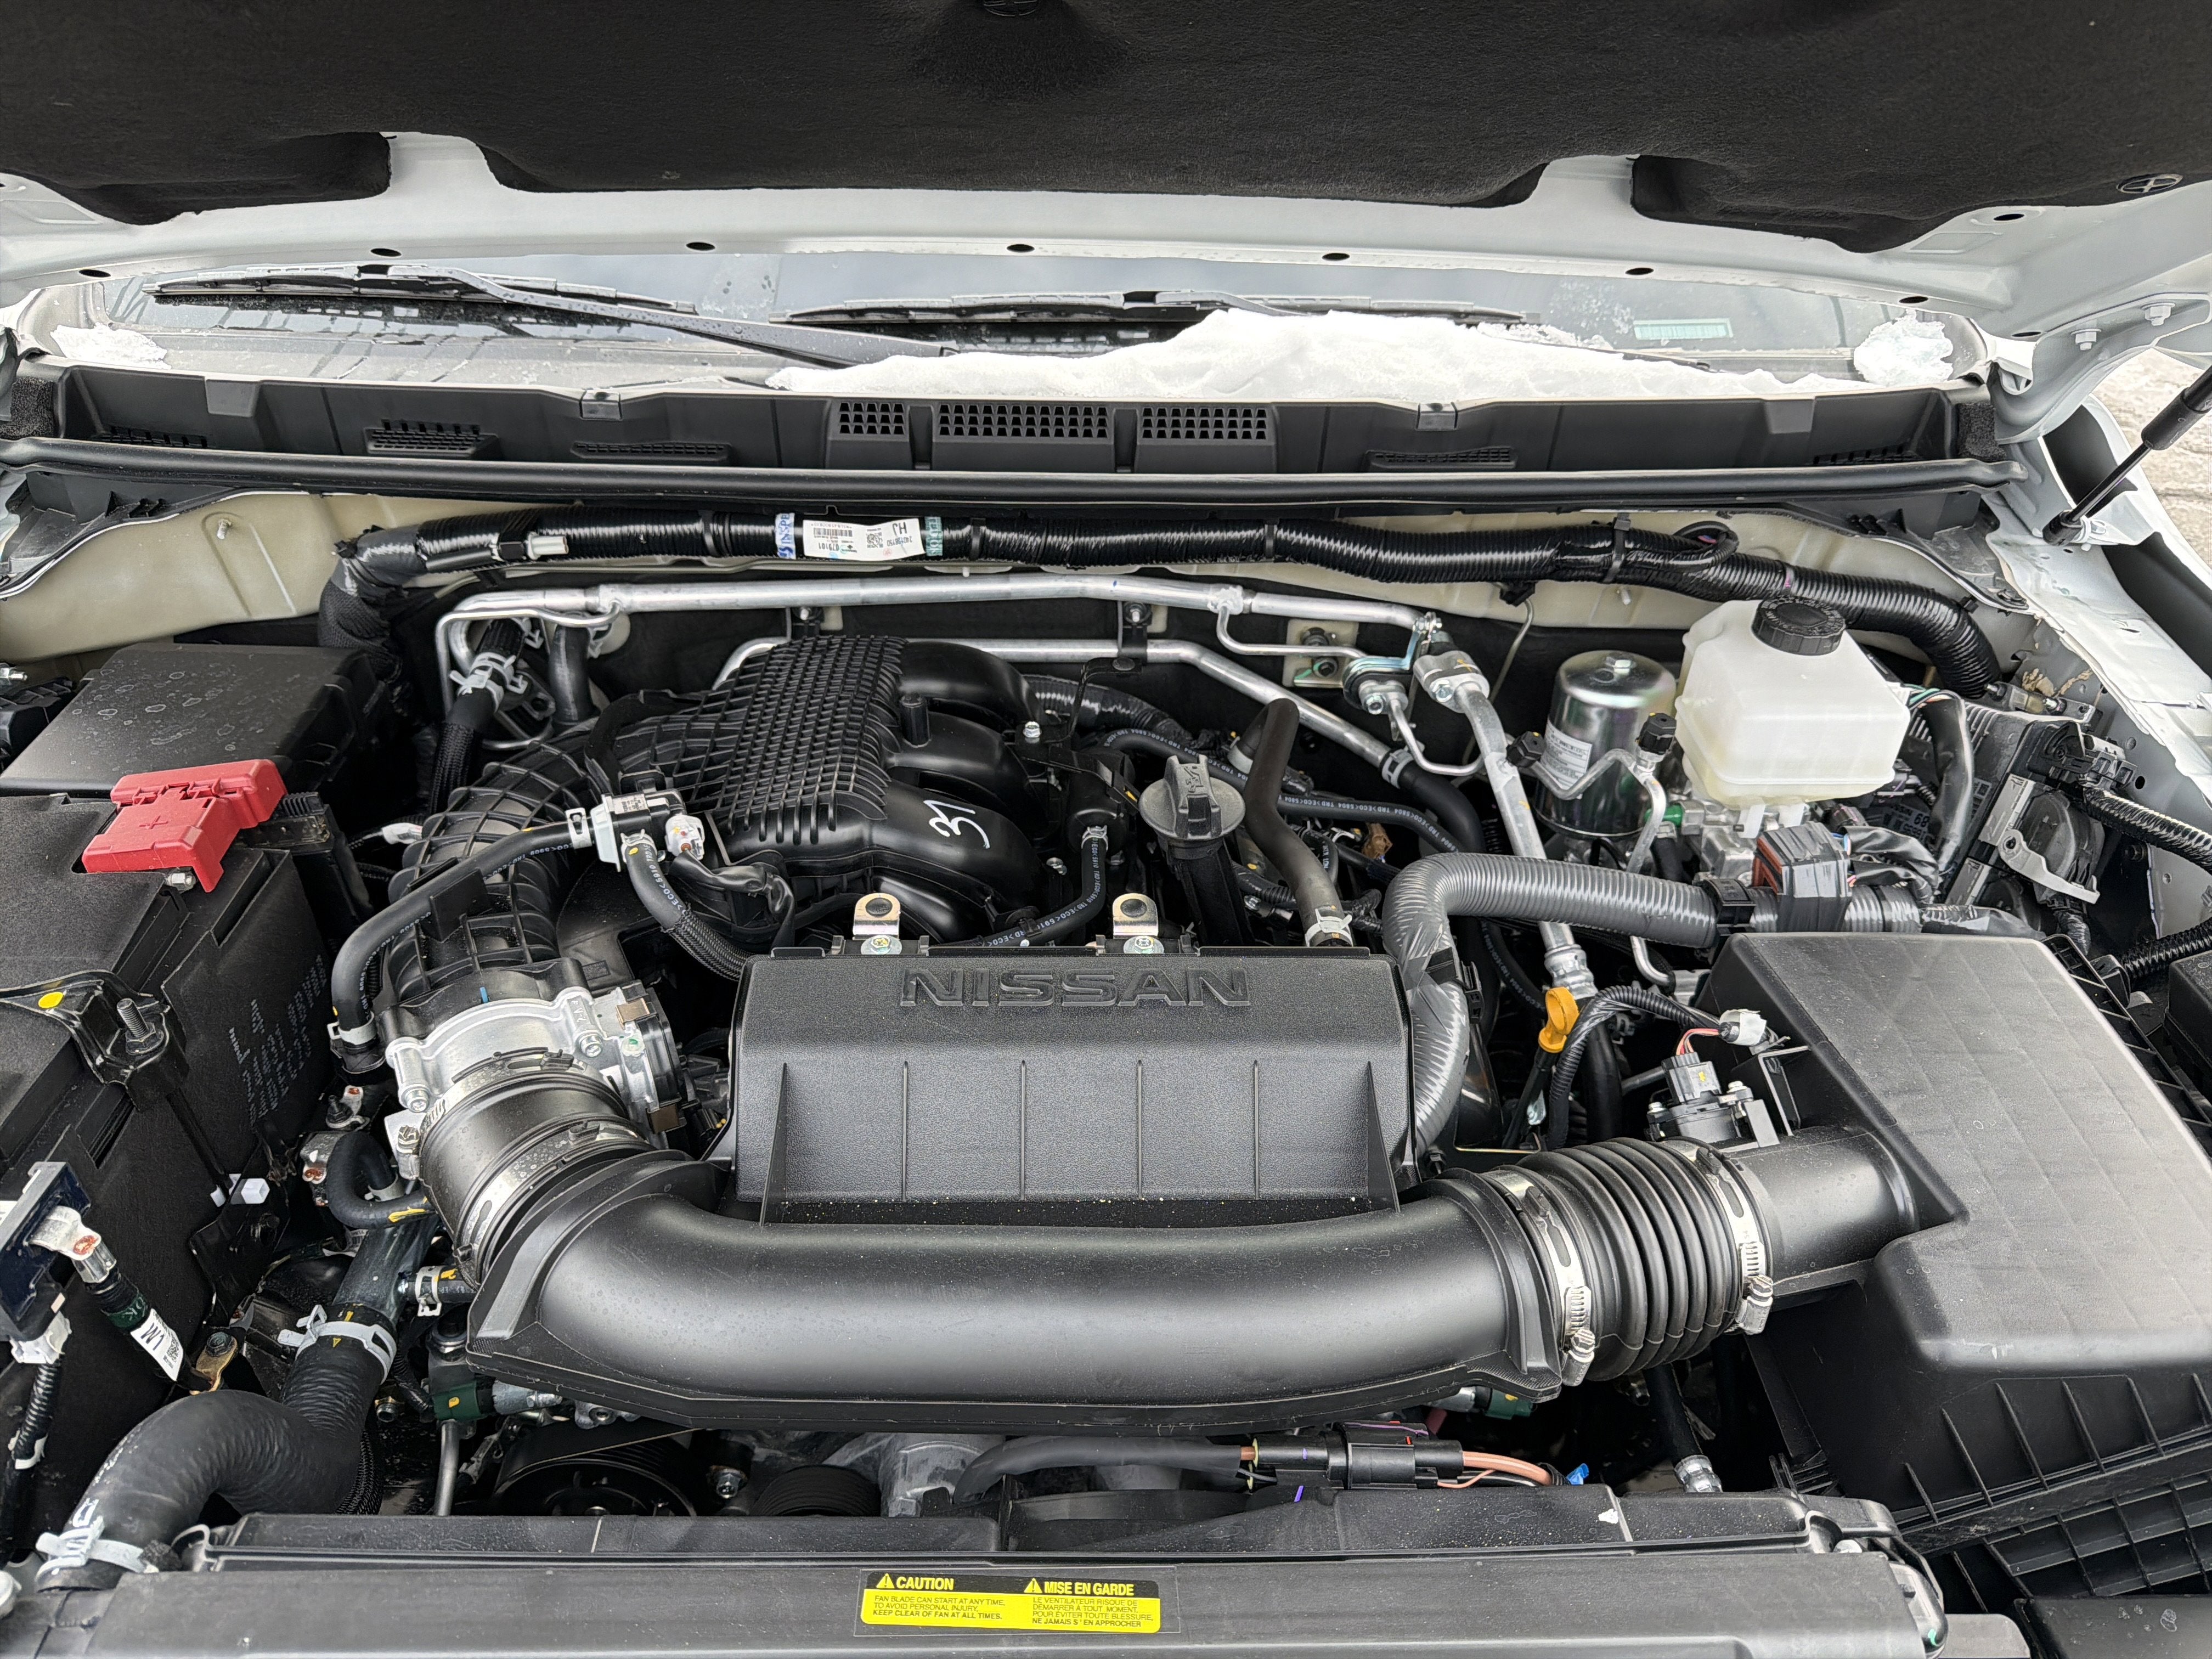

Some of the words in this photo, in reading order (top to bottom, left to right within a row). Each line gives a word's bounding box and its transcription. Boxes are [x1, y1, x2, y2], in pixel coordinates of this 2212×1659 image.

[891, 522, 907, 535] HJ
[899, 968, 1250, 1008] NISSAN
[896, 1576, 954, 1590] CAUTION
[1044, 1581, 1072, 1594] MISE
[1075, 1582, 1092, 1595] EN
[1093, 1583, 1135, 1596] GARDE
